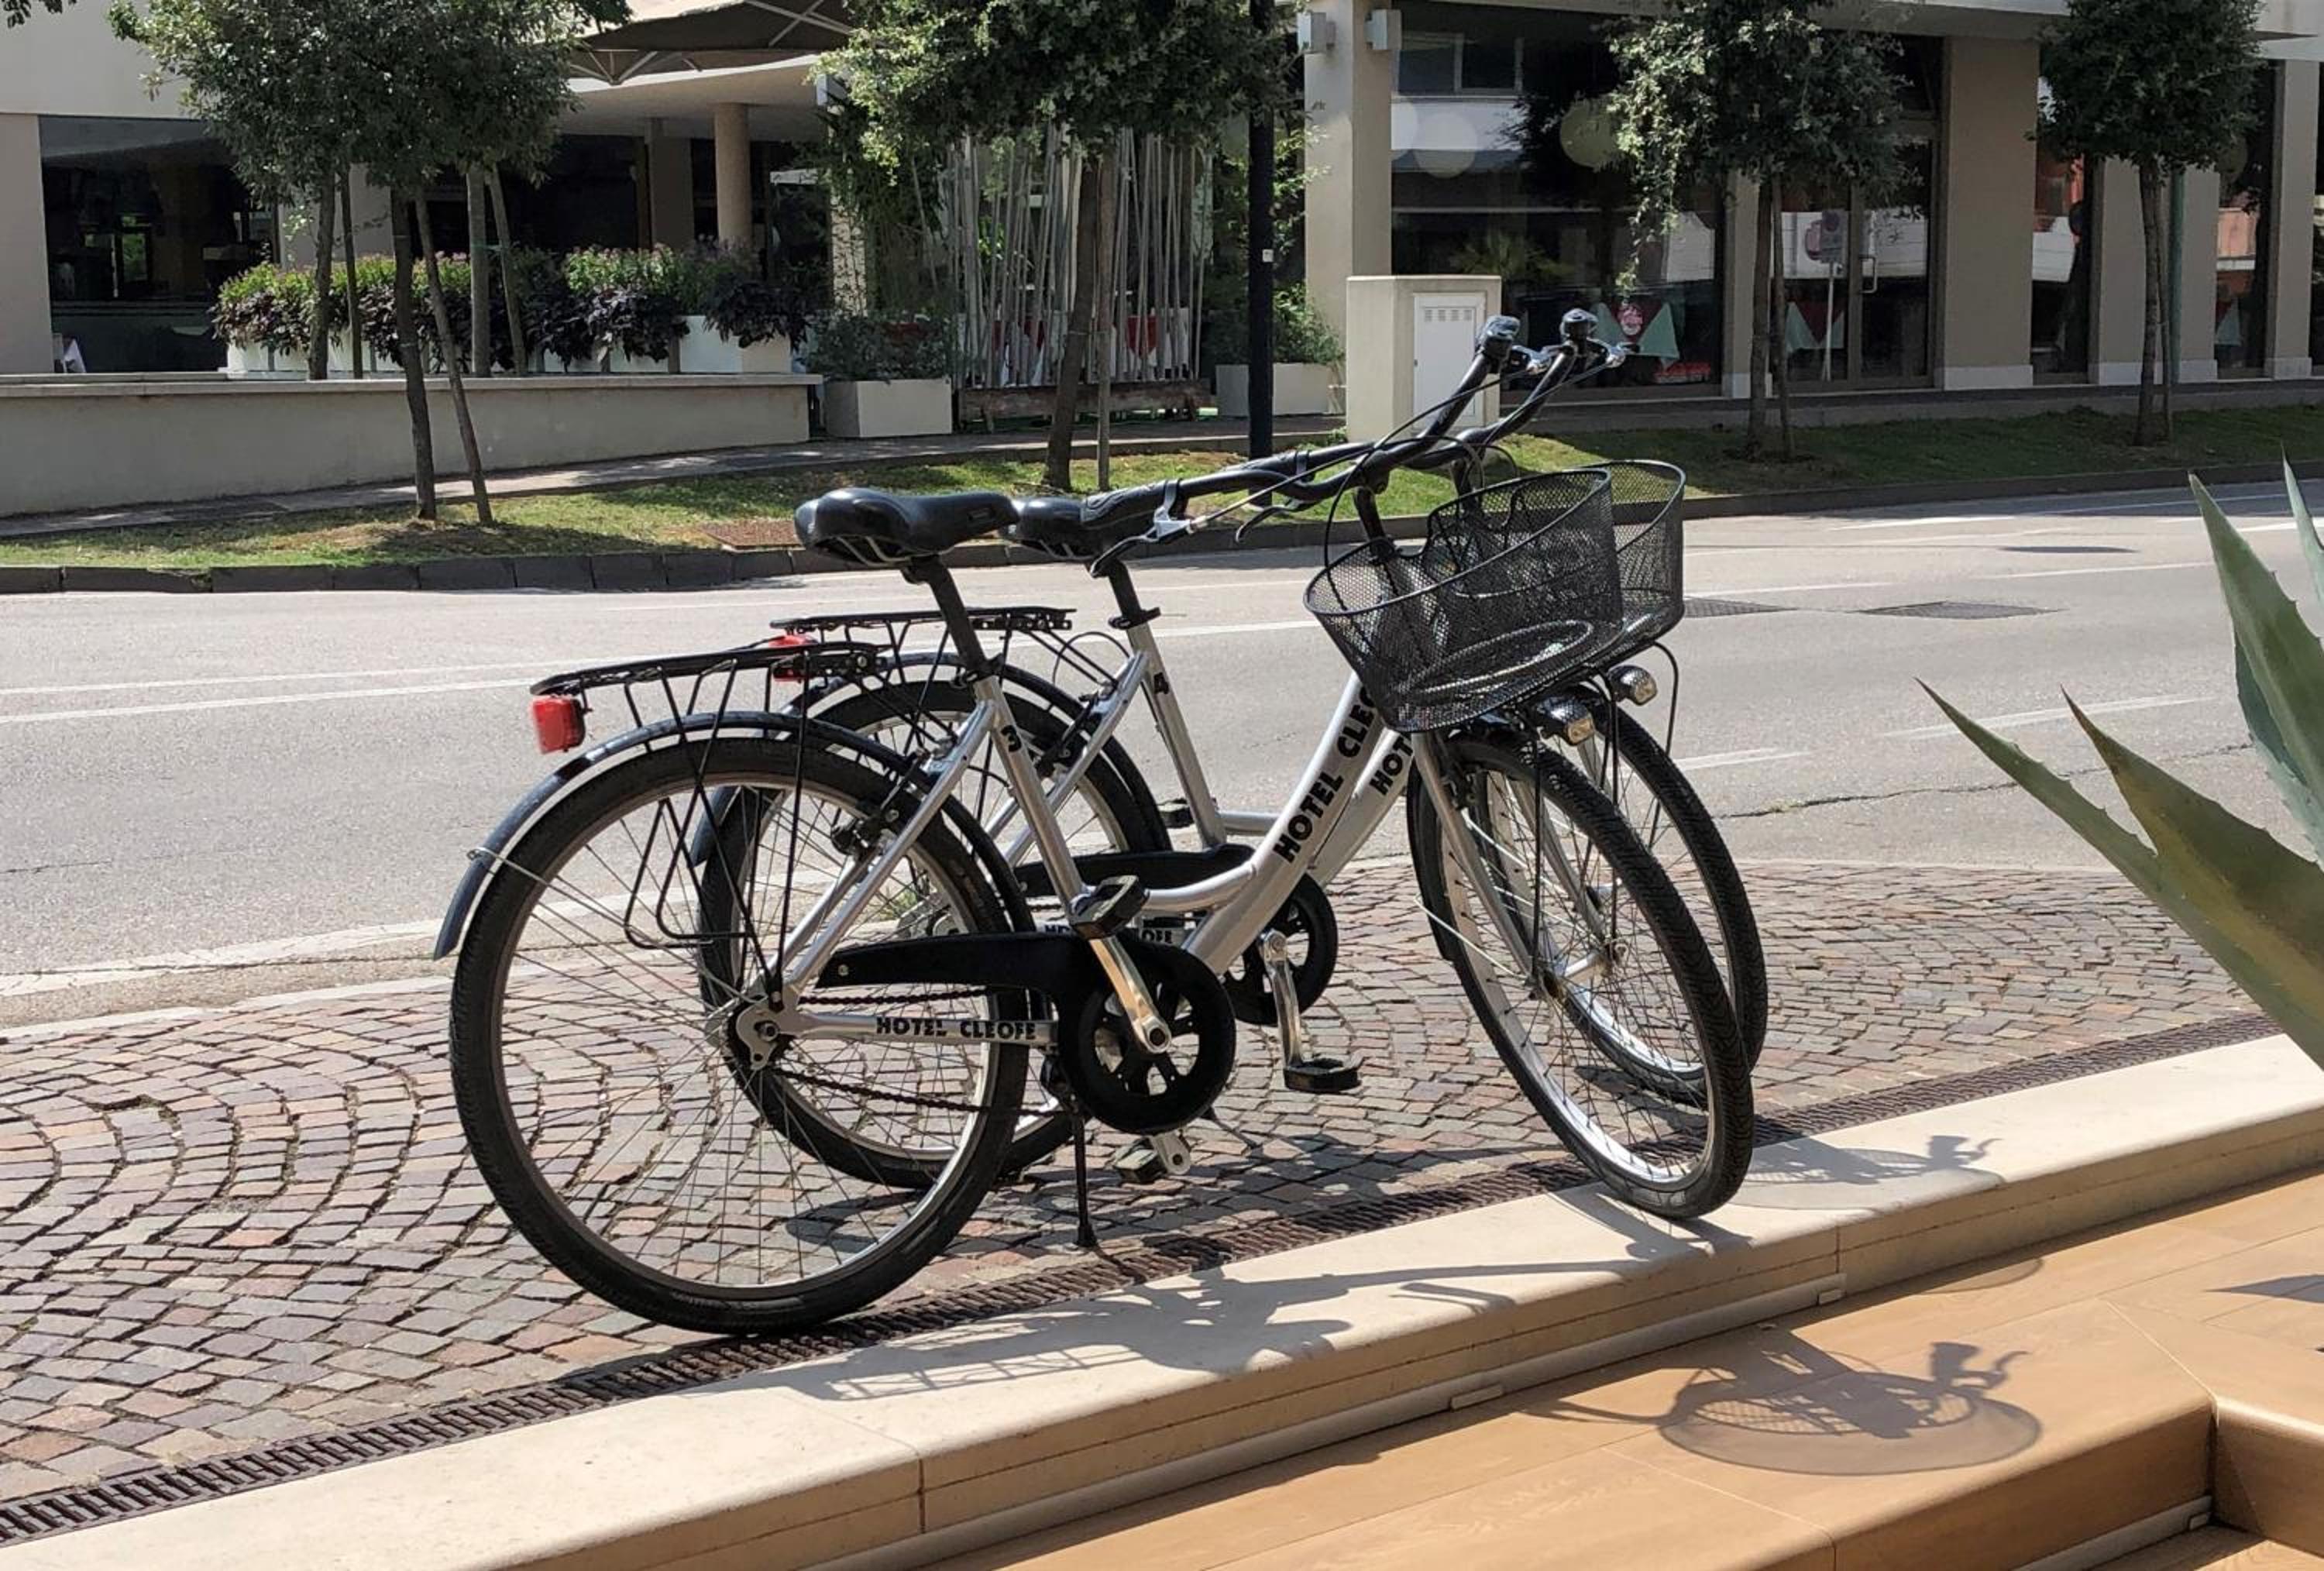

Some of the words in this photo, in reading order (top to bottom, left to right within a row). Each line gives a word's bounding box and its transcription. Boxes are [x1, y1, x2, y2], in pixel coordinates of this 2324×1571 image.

[1001, 725, 1022, 751] 3
[1273, 772, 1344, 863] HOTEL
[876, 1017, 947, 1036] HOTEL
[960, 1020, 1036, 1040] CLEOFE
